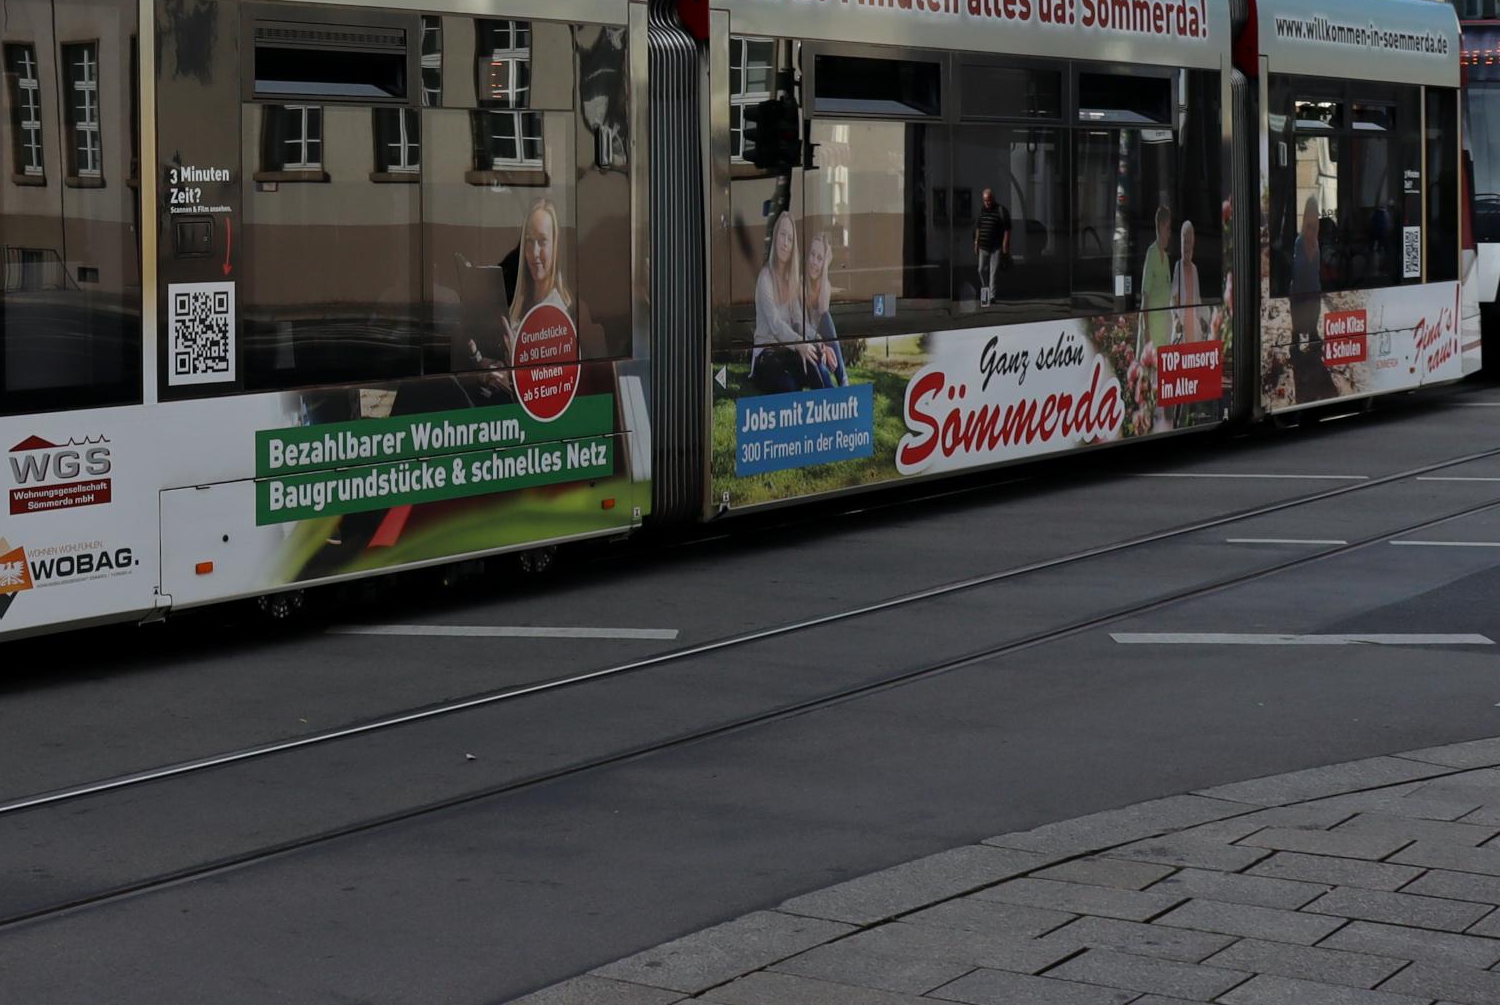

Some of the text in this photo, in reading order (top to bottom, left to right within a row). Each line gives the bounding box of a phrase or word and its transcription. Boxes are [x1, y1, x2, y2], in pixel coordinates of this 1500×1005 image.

[1275, 17, 1448, 55] www.willkommen-in-soemmerda.de
[170, 165, 230, 185] 3 Minuten
[170, 186, 202, 204] Zeit?
[521, 325, 568, 344] Grundstücke
[1326, 315, 1365, 336] Coole Kitas
[519, 351, 529, 363] ab
[530, 348, 539, 361] 90
[540, 346, 557, 359] Euro
[1332, 339, 1361, 359] Schulen
[979, 332, 1085, 392] Ganz schön
[1161, 348, 1219, 372] TOP umsorgt
[531, 366, 563, 382] Wohnen
[523, 389, 533, 402] ab
[534, 387, 539, 400] 5
[540, 384, 558, 398] Euro
[1161, 377, 1198, 399] im Alter
[742, 396, 858, 433] Jobs mit Zukunft
[901, 362, 1122, 466] Sömmerda
[269, 418, 526, 469] Bezahlbarer Wohnraum,
[741, 429, 870, 463] 300 Firmen in der Region
[9, 447, 111, 484] WGS
[269, 442, 607, 512] Baugrundstücke & schnelles Netz
[13, 482, 108, 501] Wohnungsgesellschaft
[27, 494, 94, 510] Sömmerda mbH
